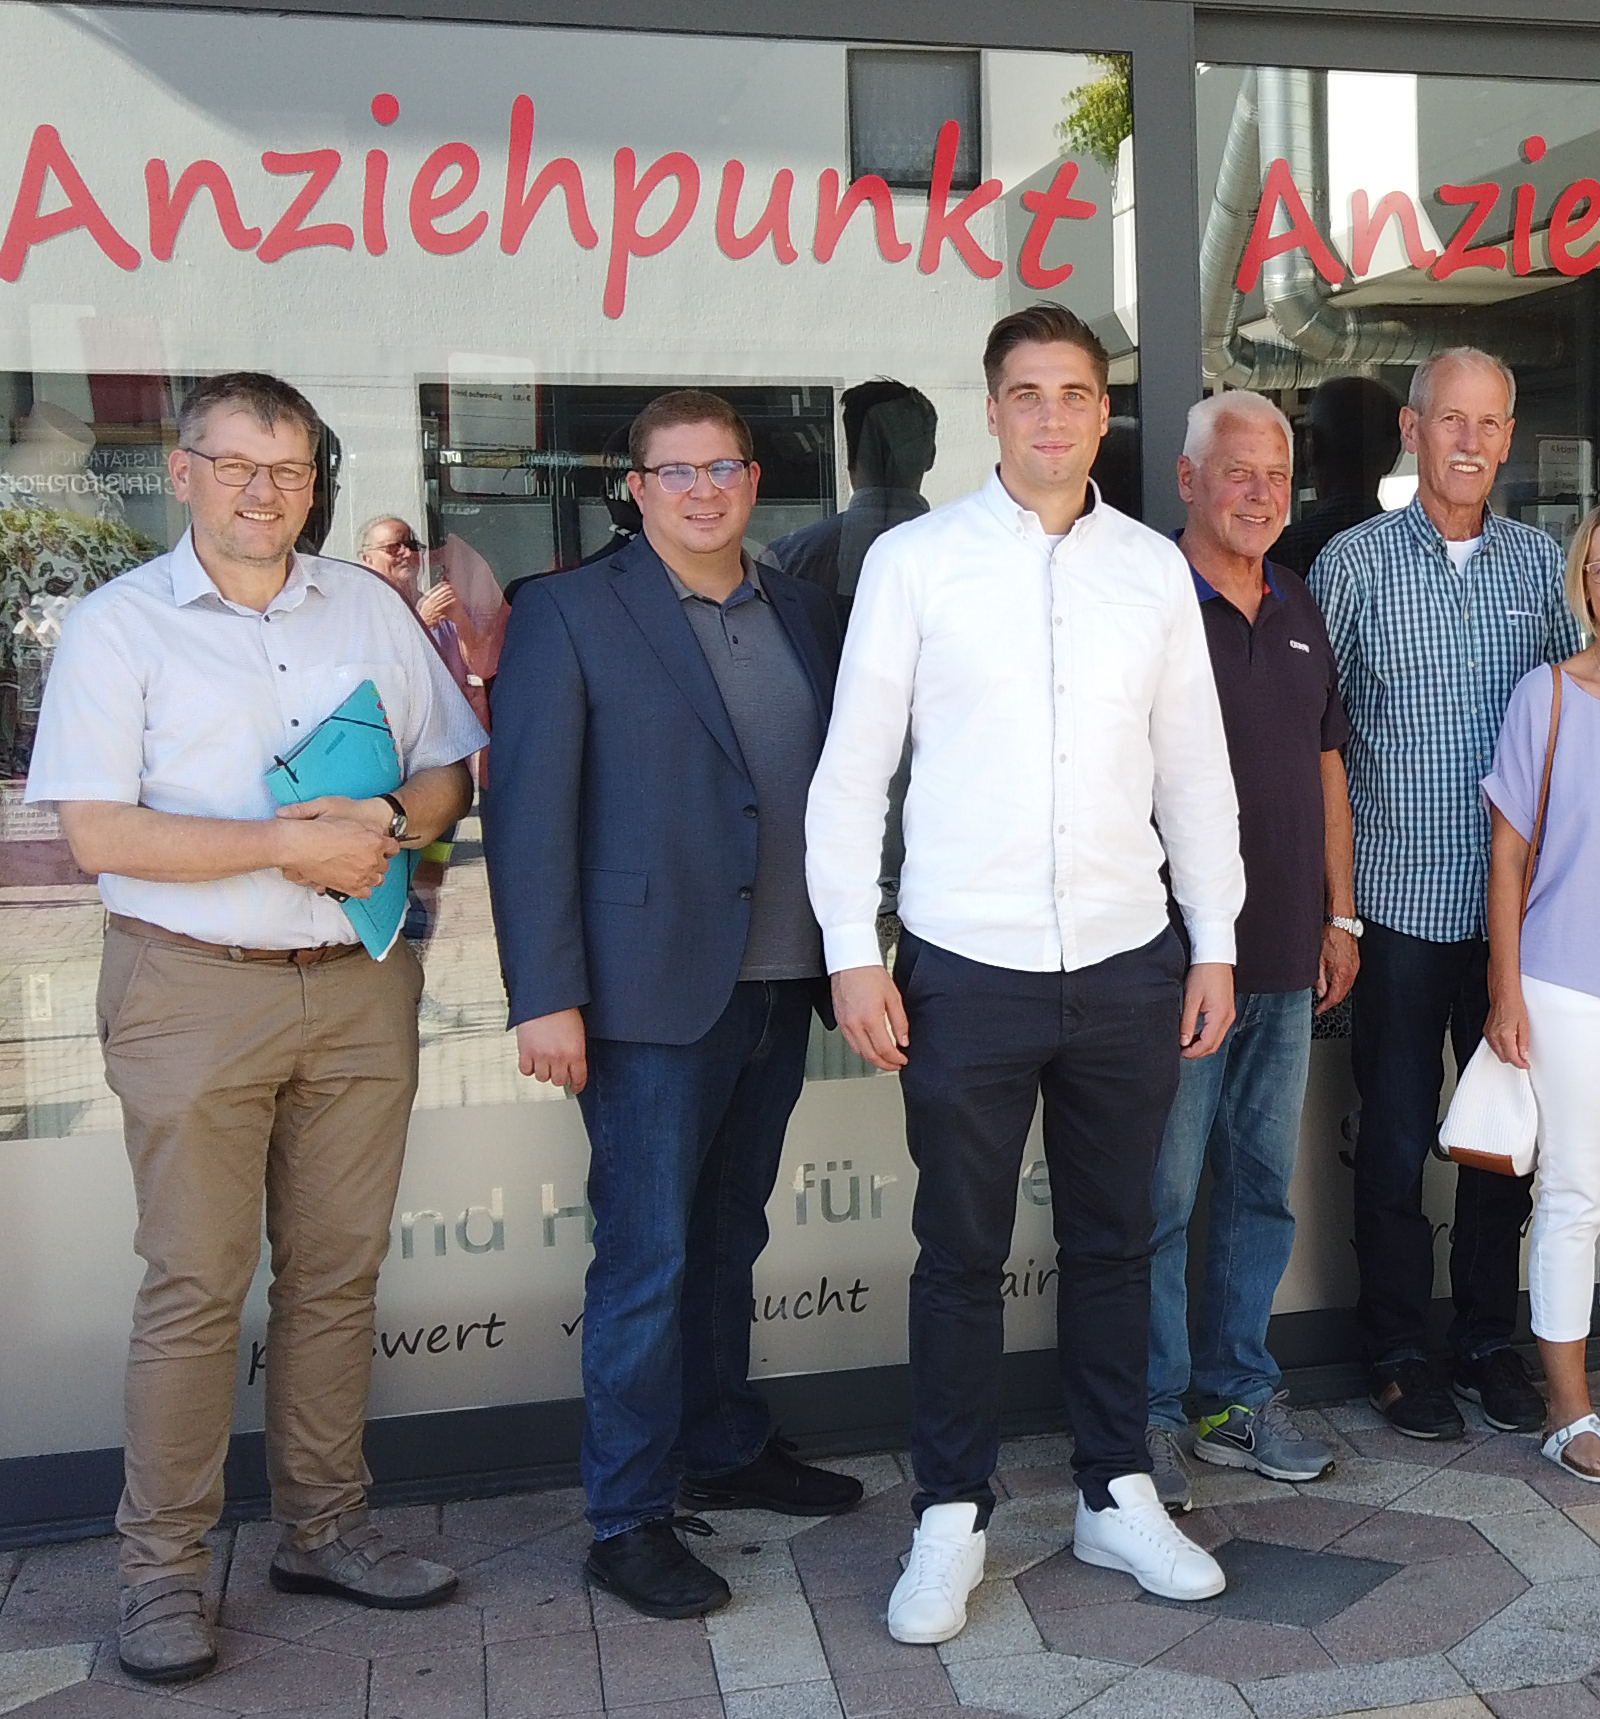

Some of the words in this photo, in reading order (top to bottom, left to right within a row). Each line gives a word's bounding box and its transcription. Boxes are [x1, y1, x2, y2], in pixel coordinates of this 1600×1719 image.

[0, 94, 1097, 318] Anziehpunkt
[791, 1160, 898, 1226] für
[1001, 1258, 1060, 1298] air
